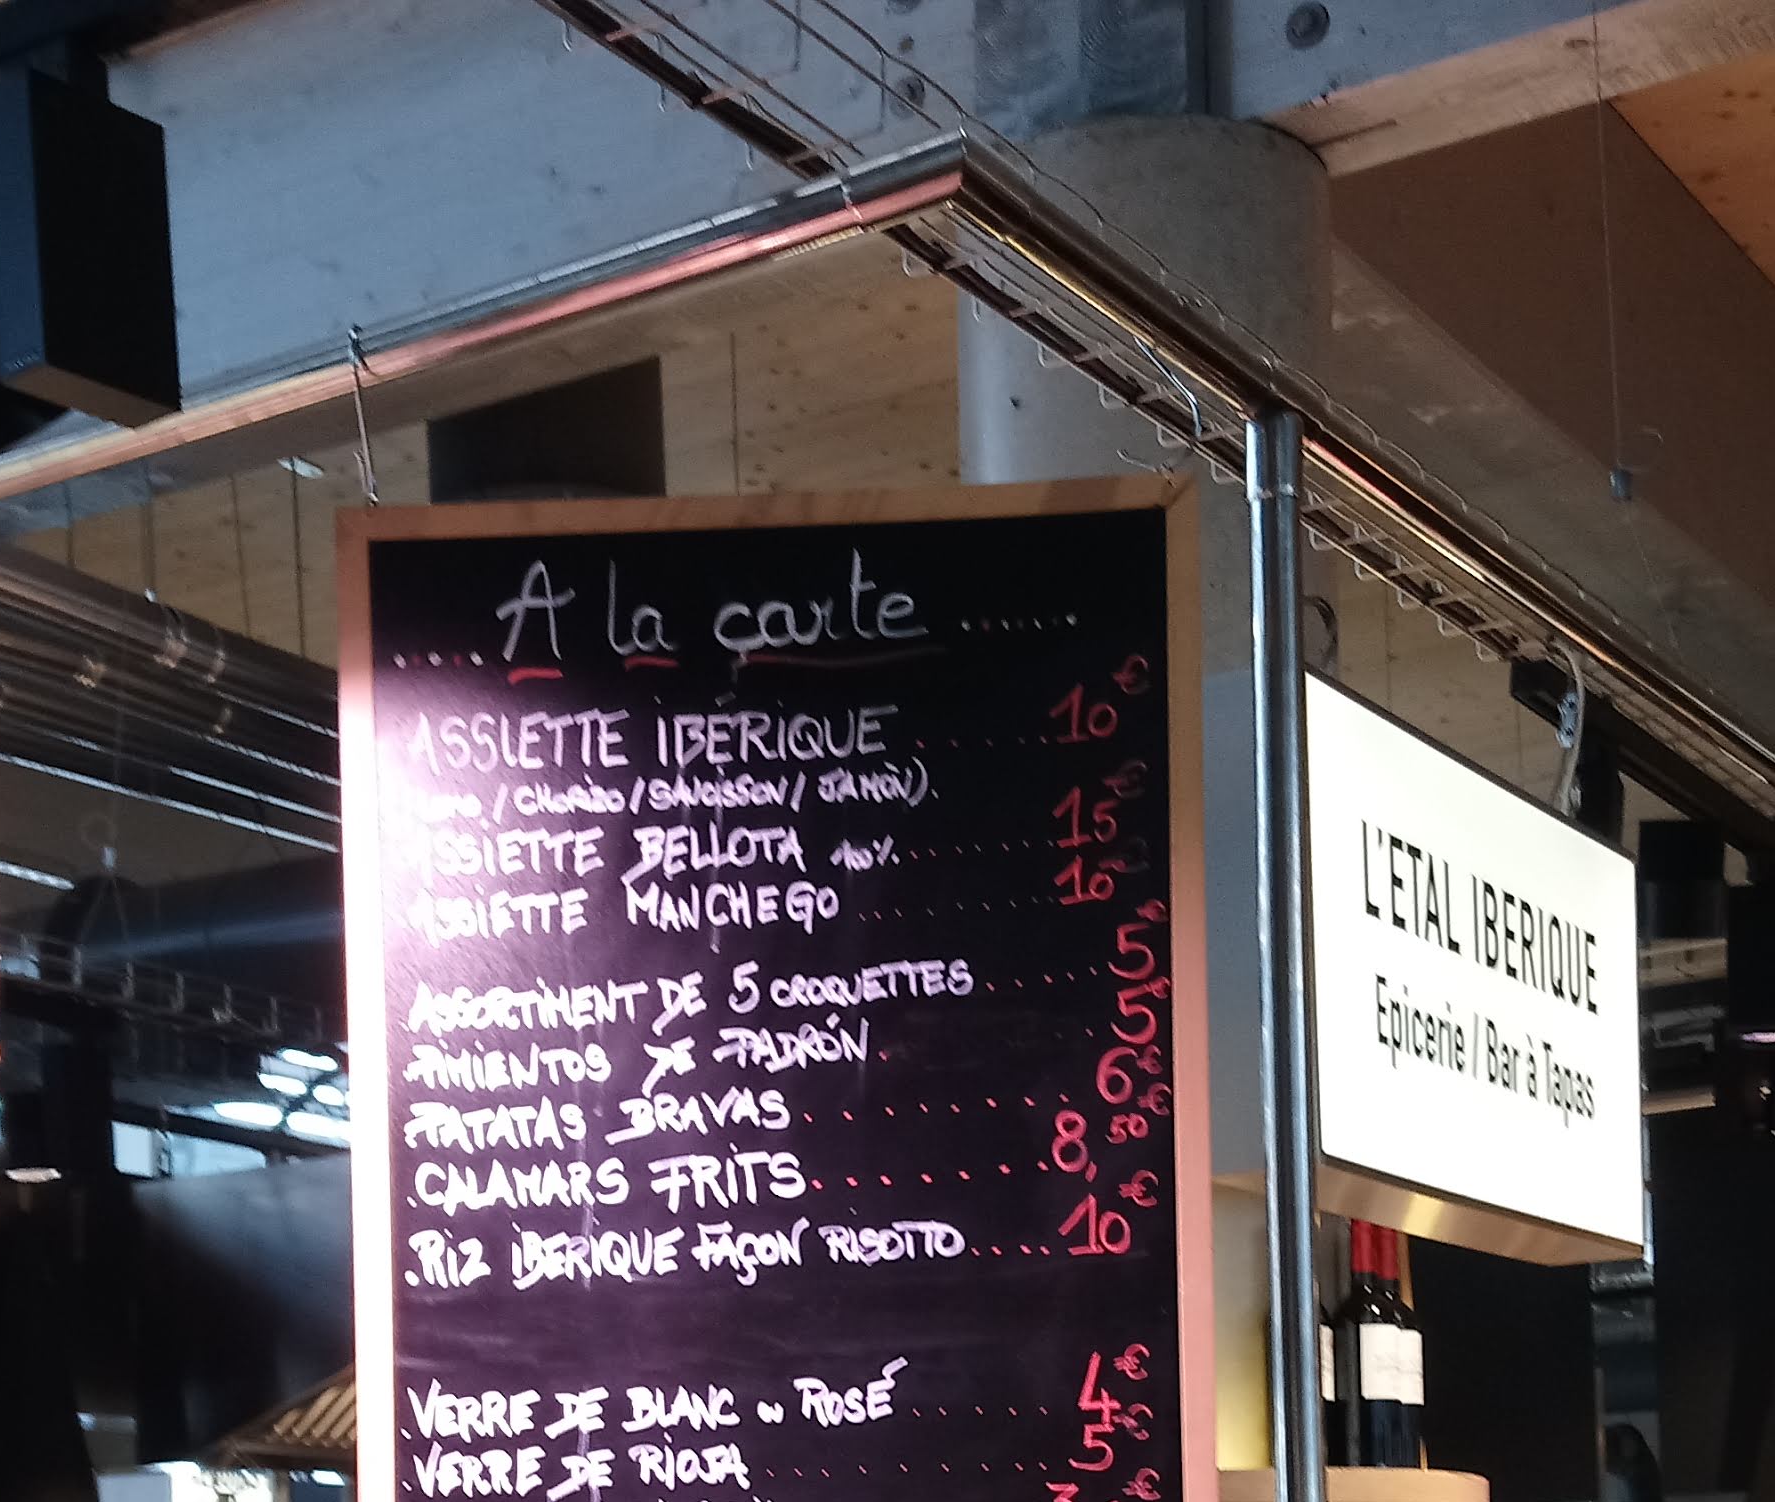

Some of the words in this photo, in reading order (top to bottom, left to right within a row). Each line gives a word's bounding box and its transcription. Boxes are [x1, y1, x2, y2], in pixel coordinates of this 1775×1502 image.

[495, 560, 575, 662] A
[608, 559, 677, 655] la
[620, 820, 806, 884] BELLOTA
[626, 881, 840, 934] MANCHEGO
[1362, 819, 1461, 956] L'ETAL
[1472, 874, 1599, 1015] IBERIQUE
[408, 977, 648, 1037] ASSORTIMENT
[652, 971, 707, 1036] DE
[728, 960, 761, 1014] 5
[770, 959, 974, 1007] CROQUETTES
[1375, 973, 1465, 1073] Epicerie
[1486, 1017, 1519, 1093] Bar
[1526, 1033, 1537, 1100] à
[1542, 1040, 1595, 1128] Tapas
[404, 1095, 587, 1154] PATATAS
[605, 1086, 790, 1146] BRAVAS
[414, 1157, 629, 1217] CALAMARS
[648, 1142, 806, 1214] FRITS
[409, 1228, 491, 1288] RIZ
[692, 1217, 810, 1286] FAÇON
[818, 1209, 965, 1267] RISOTTO
[407, 1378, 541, 1443] VERRE
[544, 1386, 609, 1439] DE
[622, 1384, 740, 1432] BLANC
[793, 1356, 908, 1428] ROSÉ
[413, 1441, 546, 1498] VERRE
[546, 1449, 615, 1501] DE
[628, 1432, 751, 1491] RIOJA
